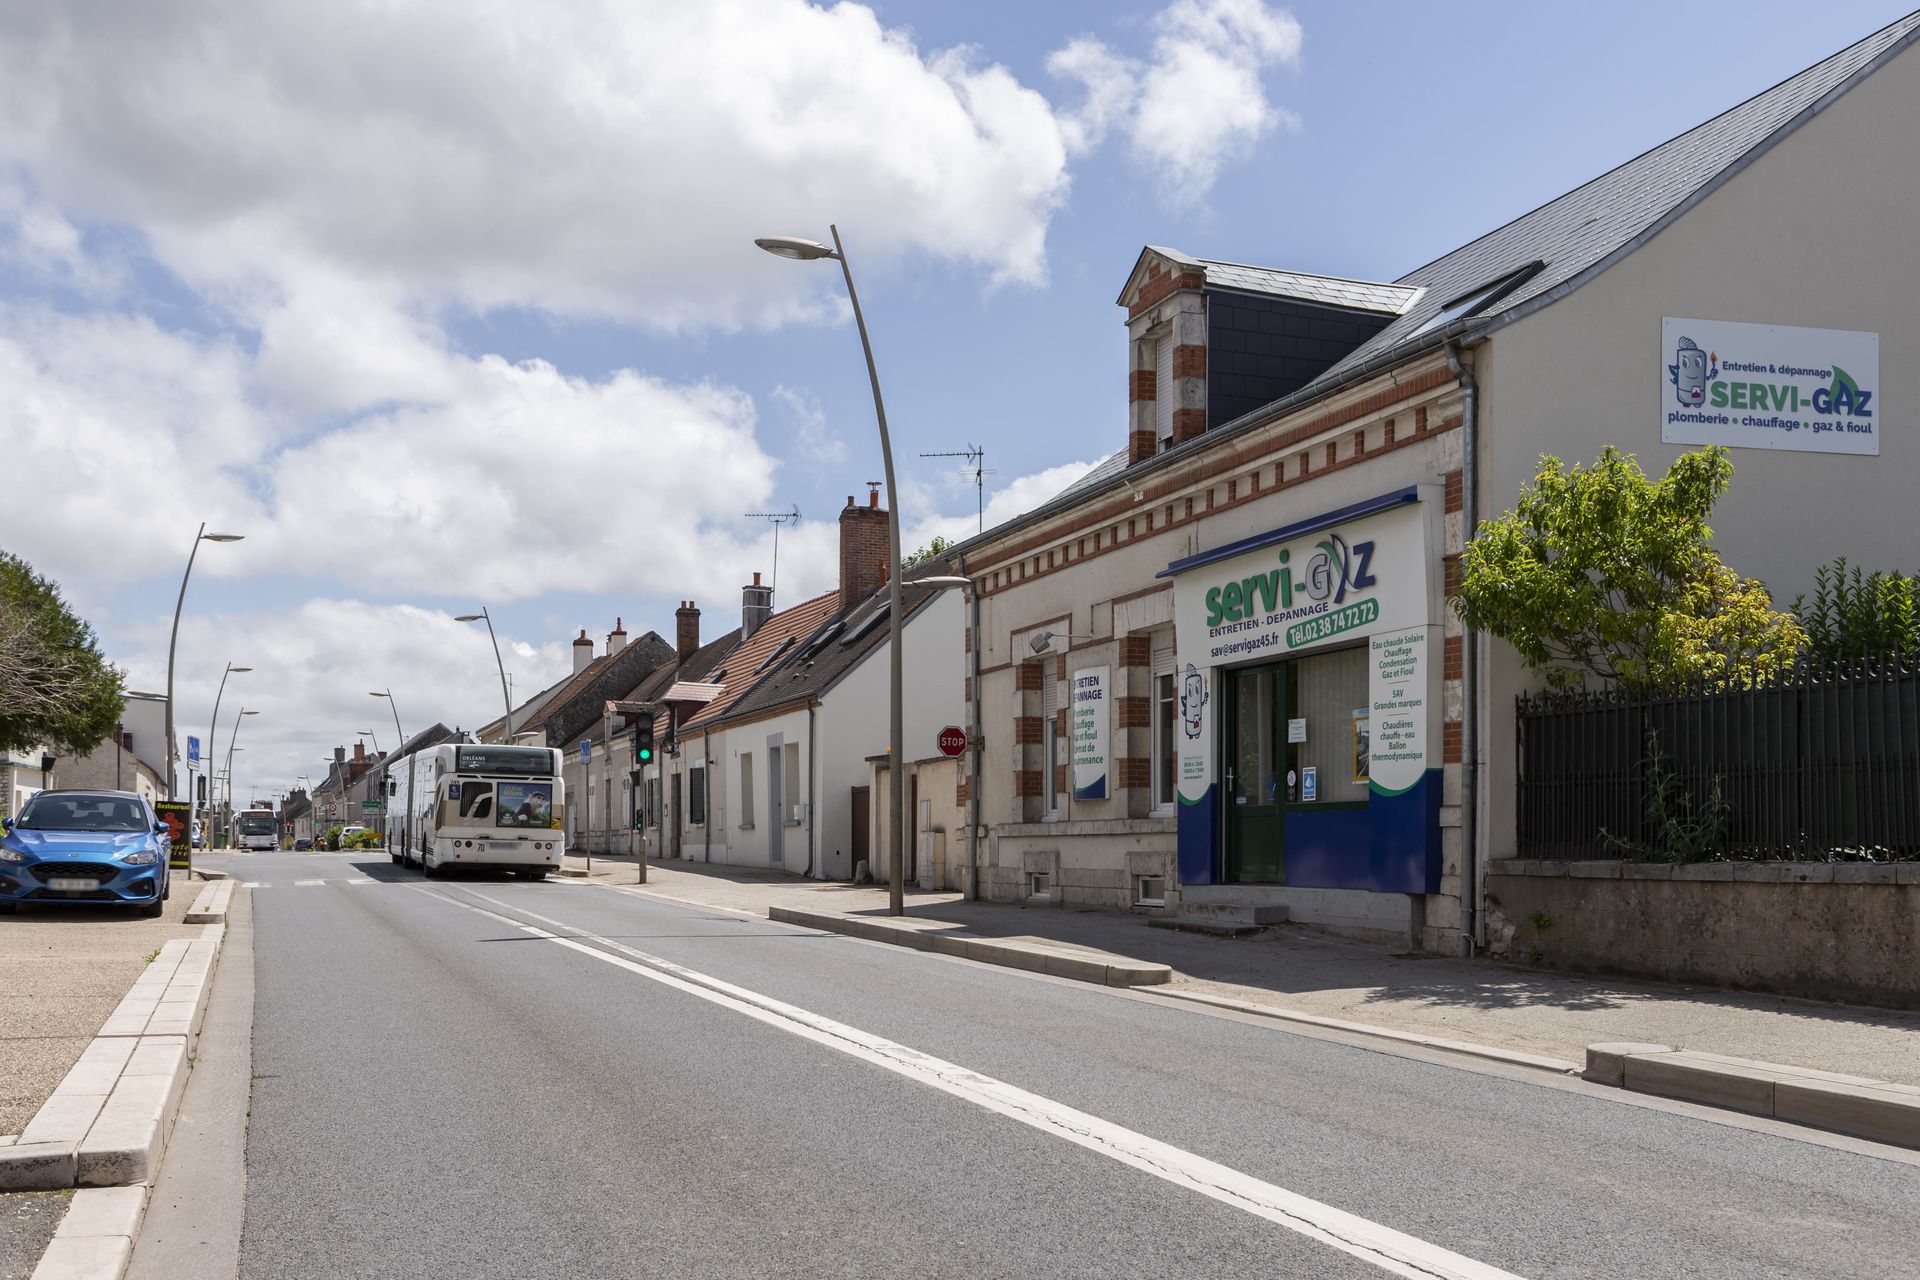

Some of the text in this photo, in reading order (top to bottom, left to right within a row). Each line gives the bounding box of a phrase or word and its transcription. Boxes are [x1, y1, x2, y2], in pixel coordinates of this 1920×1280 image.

[1722, 361, 1832, 378] Entretien & dépannage
[1710, 379, 1872, 417] SERVI-GAZ
[1668, 411, 1872, 434] plomberie chauffage gaz & fioul
[1209, 620, 1260, 638] ENTRETIEN
[1266, 602, 1329, 626] DEPANNAGE
[1319, 618, 1332, 635] 38
[1332, 613, 1345, 631] 74
[1346, 608, 1360, 626] 72
[1361, 603, 1375, 621] 72
[1211, 633, 1279, 657] sav@servigaz45.fr
[1373, 634, 1424, 650] Eau chaude Solaire
[1384, 647, 1412, 658] Chauffage
[1379, 656, 1417, 669] Condensation
[1382, 667, 1415, 679] Gaz et Fioul
[1392, 689, 1404, 698] SAV
[1374, 699, 1422, 710] Grandes marques
[1382, 721, 1413, 730] Chaudières
[1084, 729, 1097, 741] fioul
[1380, 732, 1400, 740] chauffe
[941, 737, 964, 747] STOP
[1087, 743, 1095, 752] de
[1388, 741, 1406, 750] Ballon
[1372, 751, 1423, 762] thermodynamique
[477, 843, 485, 852] 70
